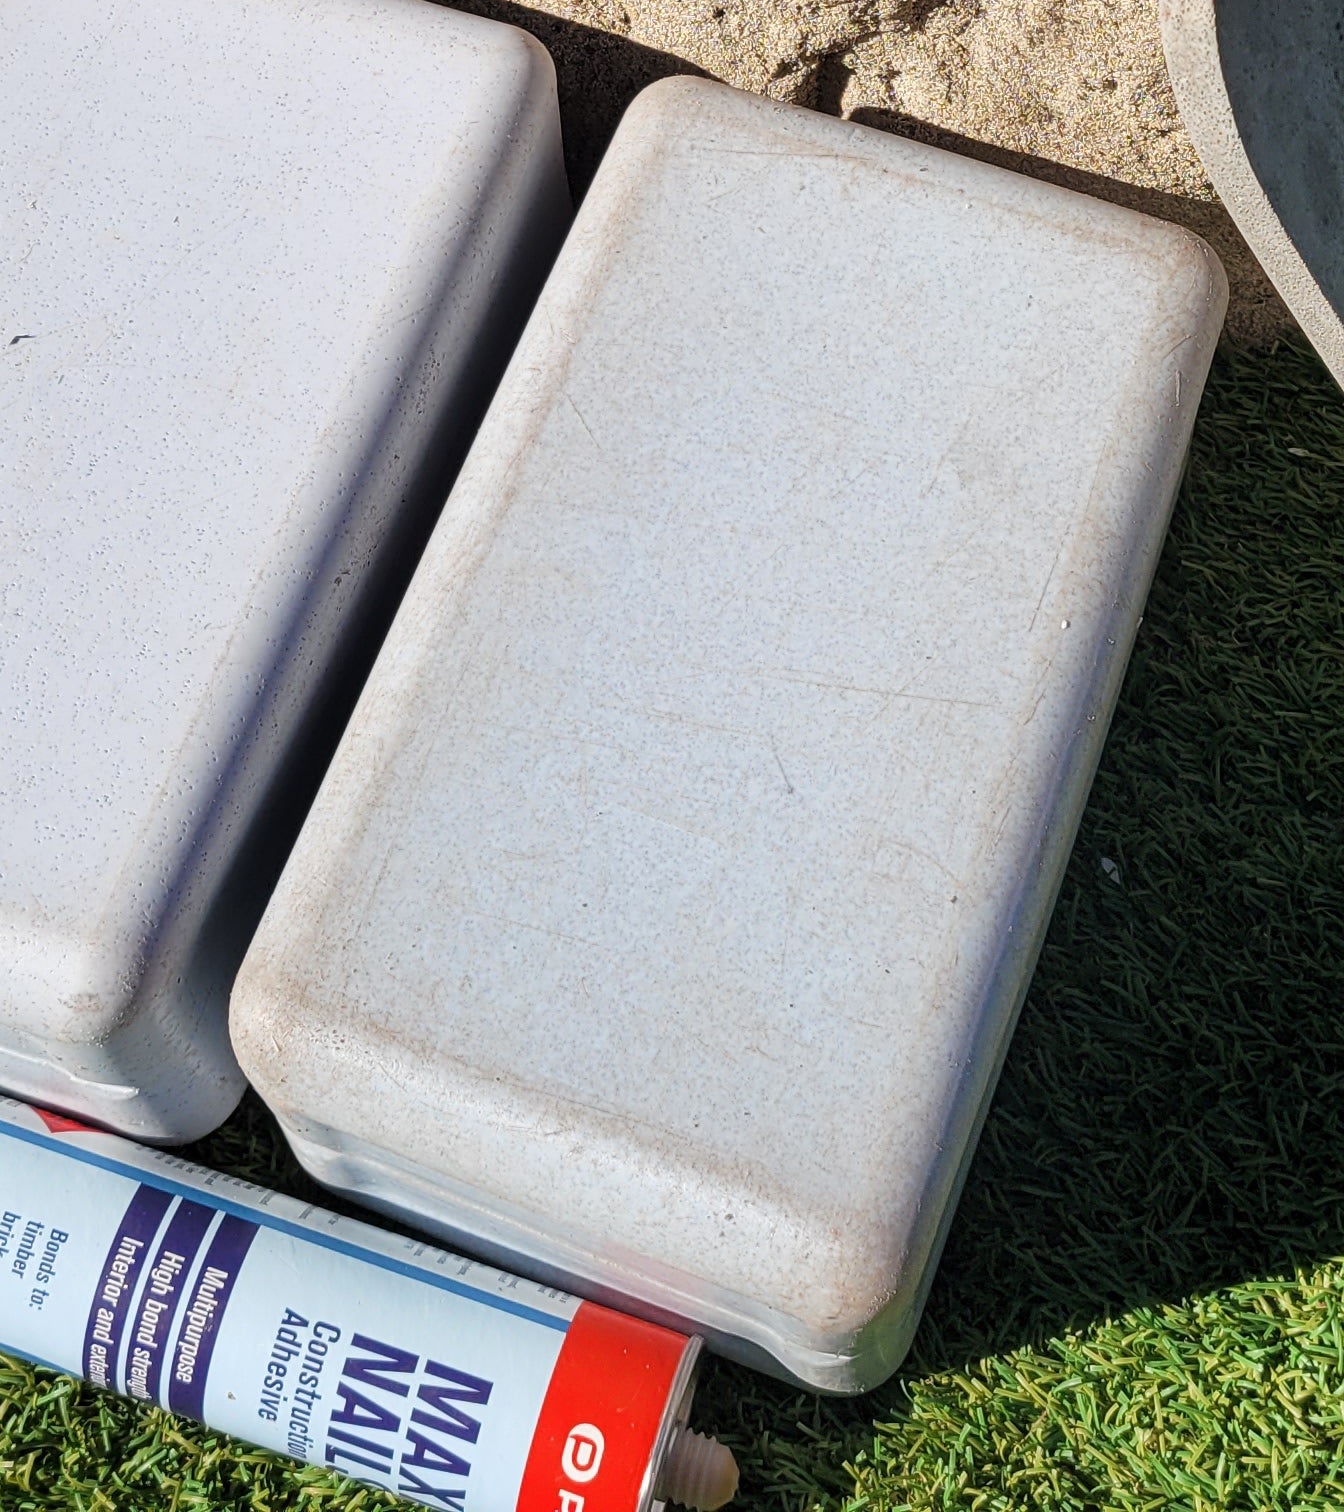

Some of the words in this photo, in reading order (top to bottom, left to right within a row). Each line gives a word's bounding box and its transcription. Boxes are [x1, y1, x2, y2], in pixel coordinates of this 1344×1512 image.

[10, 1220, 45, 1279] timber
[35, 1228, 69, 1283] Bonds
[102, 1235, 145, 1308] Interior
[151, 1250, 186, 1296] High
[28, 1286, 51, 1311] to:
[92, 1307, 115, 1345] and
[136, 1298, 169, 1349] bond
[175, 1266, 229, 1384] Multipurpose
[258, 1307, 310, 1422] Adhesive
[286, 1321, 342, 1460] Construction
[324, 1333, 420, 1492] NAIL
[397, 1359, 494, 1512] MAX
